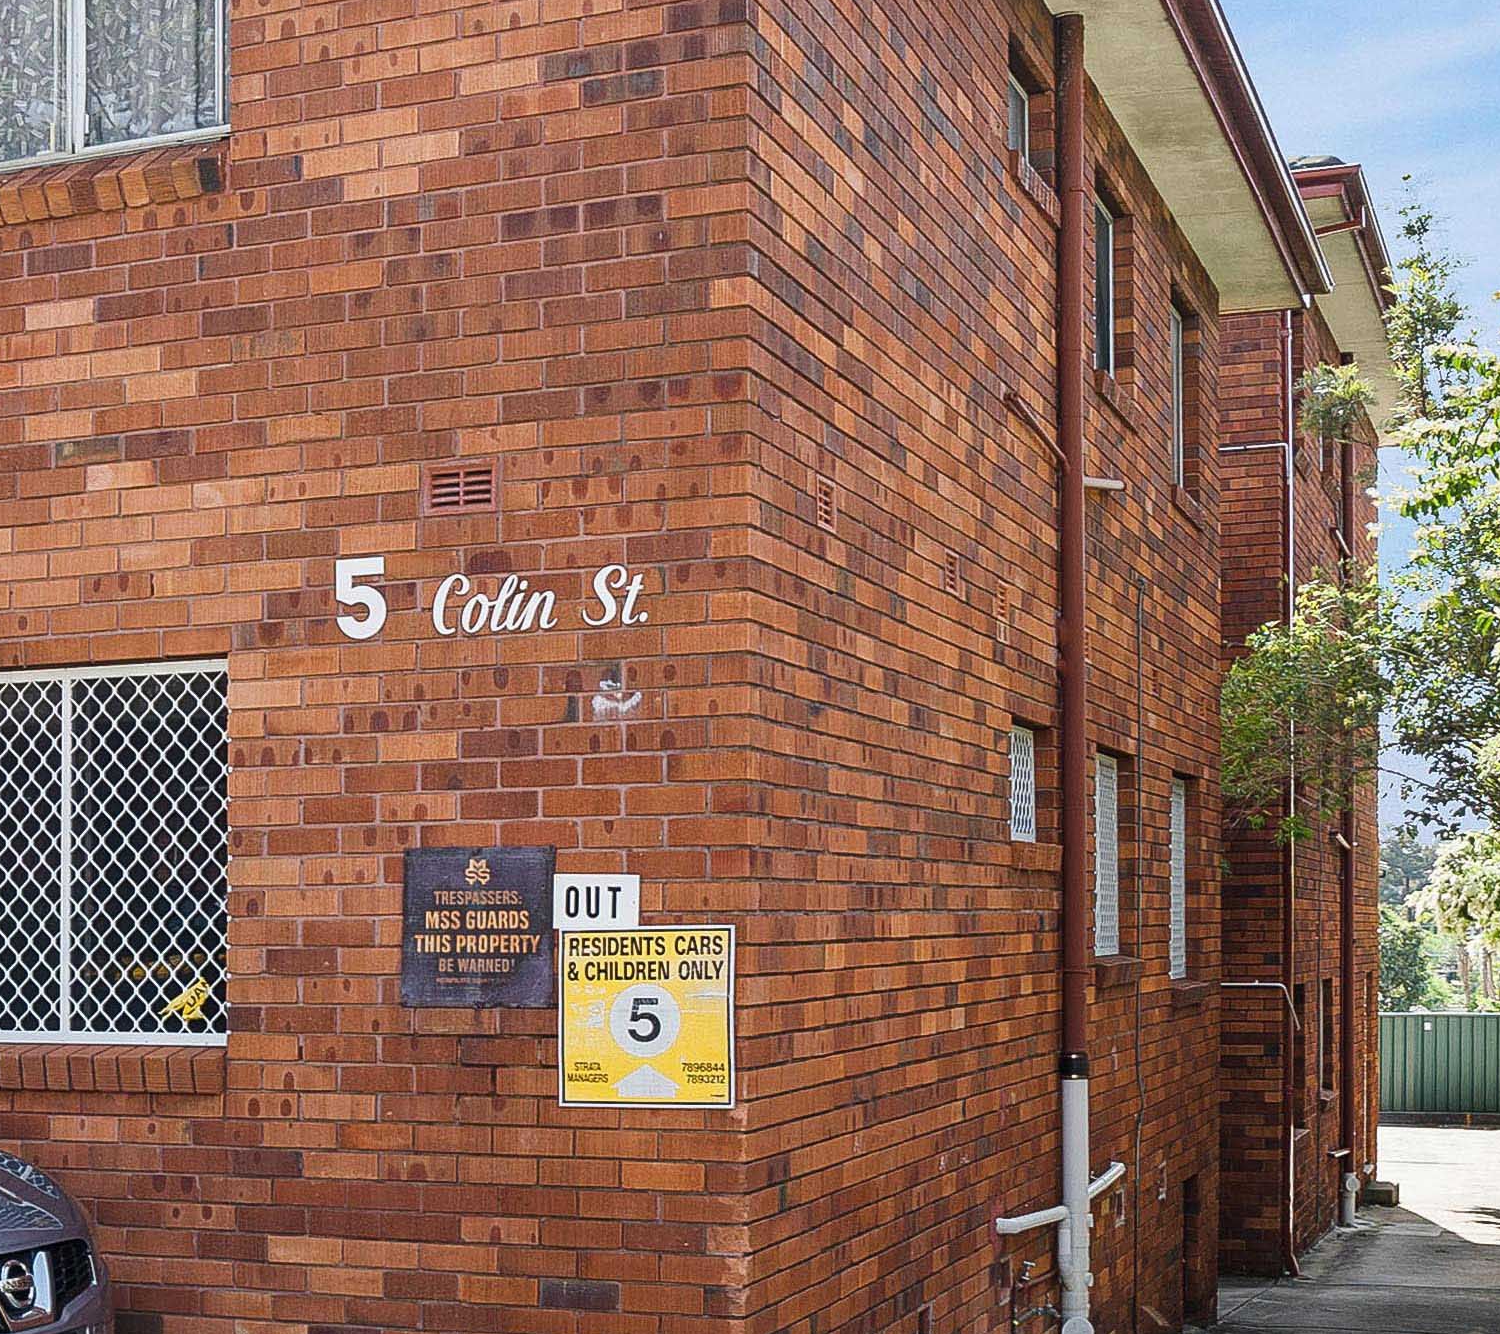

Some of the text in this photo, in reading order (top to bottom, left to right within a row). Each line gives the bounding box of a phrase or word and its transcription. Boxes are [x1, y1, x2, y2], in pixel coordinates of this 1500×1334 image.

[336, 556, 649, 640] 5 Colin St.
[433, 890, 523, 906] TRESPASSERS:
[565, 885, 622, 919] OUT
[425, 910, 529, 930] MSS GUARDS
[414, 934, 541, 954] THIS PROPERTY
[568, 935, 724, 957] RESIDENTS CARS
[438, 958, 515, 973] BE WARNED!
[567, 960, 724, 981] & CHILDREN ONLY
[627, 997, 662, 1043] 5
[567, 1073, 609, 1083] MANAGERS
